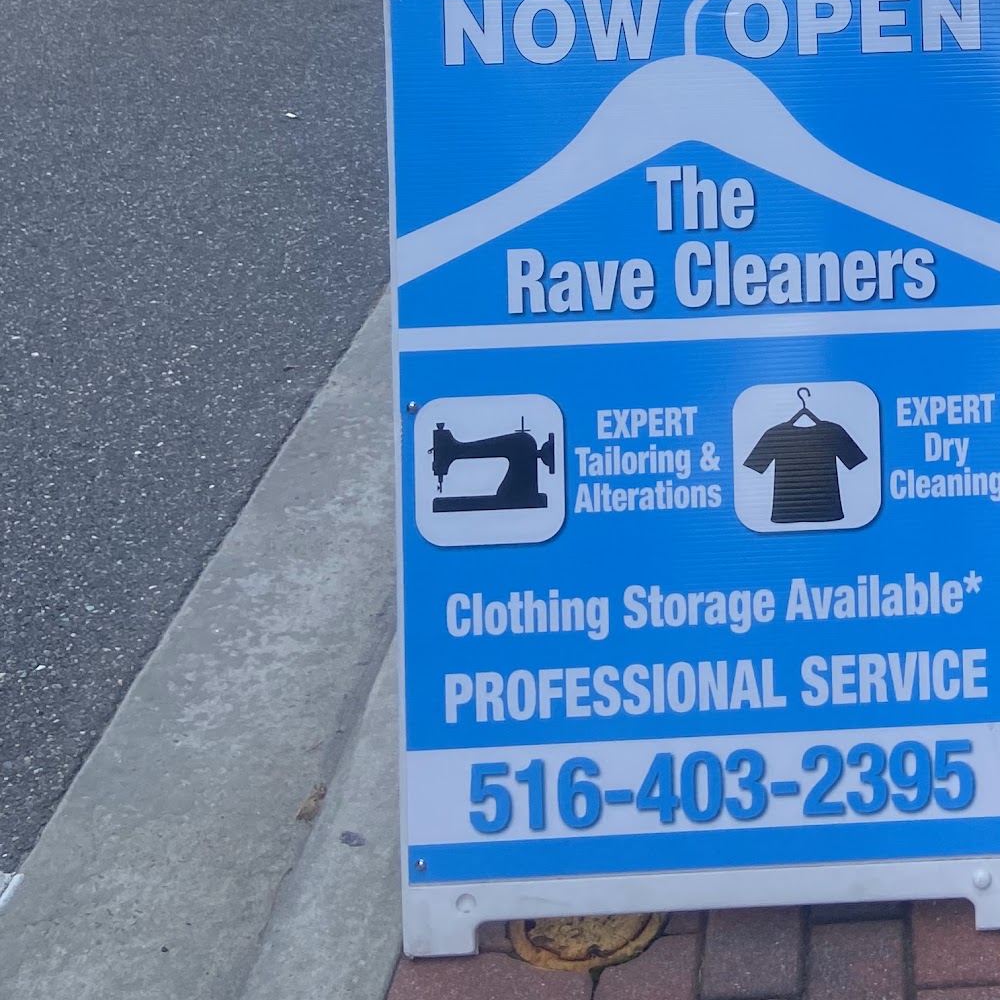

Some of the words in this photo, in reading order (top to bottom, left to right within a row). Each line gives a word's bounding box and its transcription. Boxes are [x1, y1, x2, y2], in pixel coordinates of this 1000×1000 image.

[645, 165, 755, 231] The
[506, 248, 655, 314] Rave
[674, 240, 936, 308] Cleaners
[597, 406, 698, 439] EXPERT
[896, 394, 996, 427] EXPERT
[574, 445, 692, 480] Tailoring
[699, 442, 721, 472] &
[924, 432, 970, 467] Dry
[574, 480, 722, 513] Alterations
[446, 590, 610, 641] Clothing
[623, 584, 775, 634] Storage
[444, 659, 787, 724] PROFESSIONAL
[800, 648, 989, 706] SERVICE
[468, 739, 977, 834] 516-403-2395
